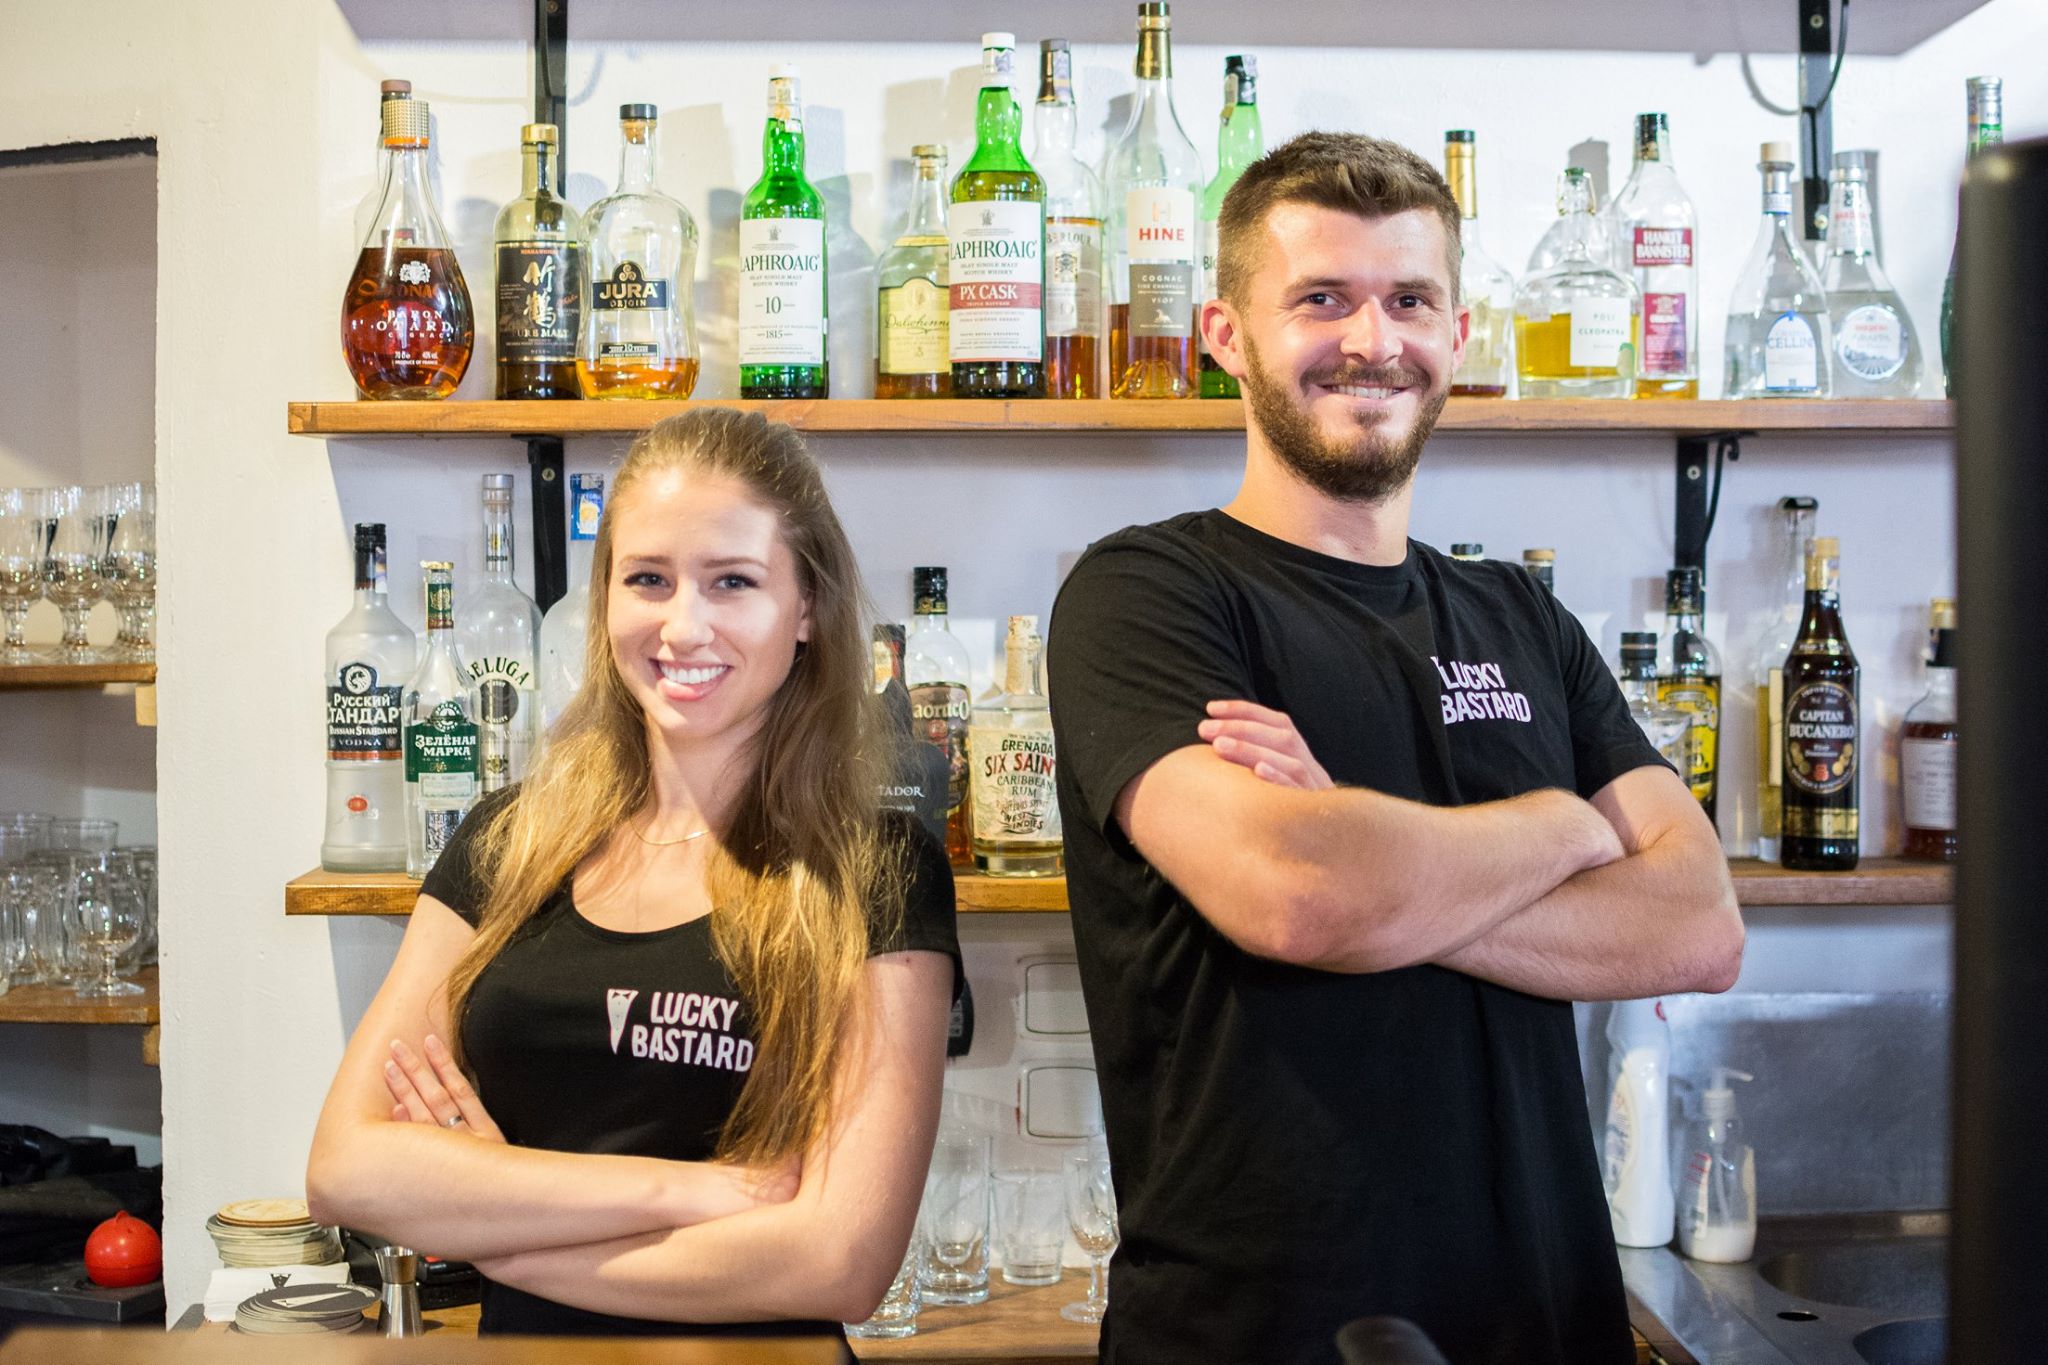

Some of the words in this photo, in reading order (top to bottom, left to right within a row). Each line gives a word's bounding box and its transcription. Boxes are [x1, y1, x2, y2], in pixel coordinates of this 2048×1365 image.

[1138, 227, 1185, 241] HINE
[1141, 274, 1183, 282] COGNAC
[599, 283, 658, 299] JURA
[959, 285, 976, 300] PX
[978, 284, 1018, 300] CASK
[609, 299, 647, 308] ORIGIN
[765, 295, 782, 314] 10
[765, 330, 783, 339] 1815
[1439, 660, 1506, 690] LUCKY
[328, 706, 402, 725] ТАНДАР
[1440, 690, 1532, 725] BASTARD
[1799, 709, 1845, 722] CAPITAN
[1788, 722, 1855, 739] BUCANERO
[338, 738, 382, 746] VODKA
[1001, 739, 1054, 757] GRENADA
[423, 746, 471, 757] МАРКА
[984, 752, 1008, 777] SIX
[1013, 752, 1056, 777] SAIN
[996, 774, 1053, 791] CARIBBEAN
[878, 784, 926, 798] TADOR
[1011, 785, 1037, 798] RUM
[650, 991, 739, 1032] LUCKY
[631, 1024, 754, 1073] BASTARD
